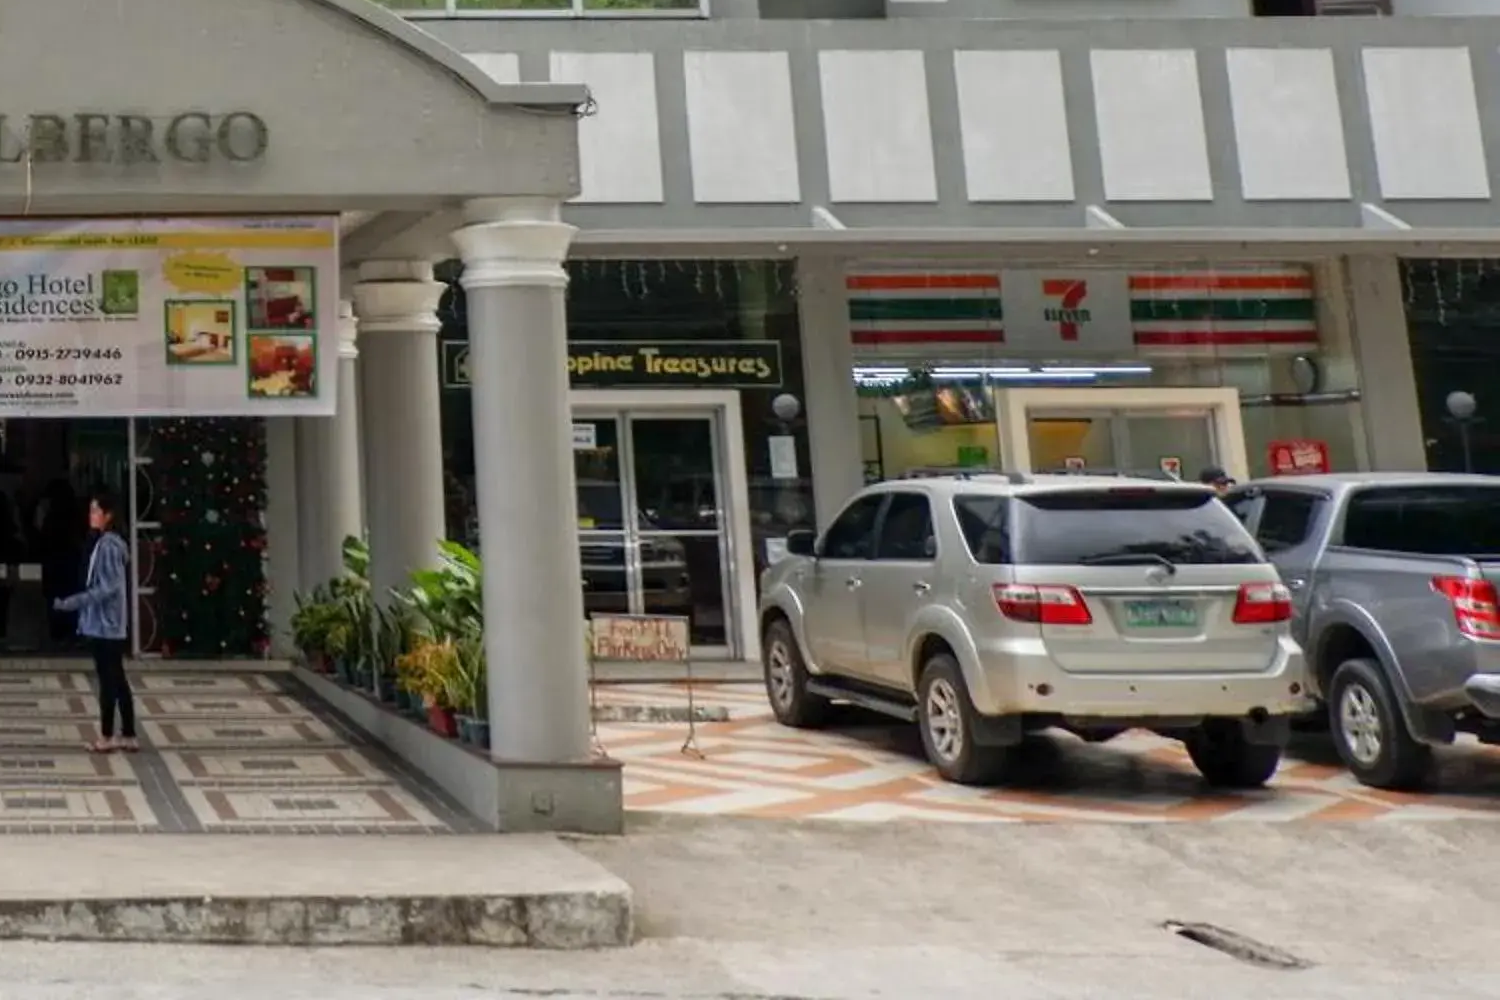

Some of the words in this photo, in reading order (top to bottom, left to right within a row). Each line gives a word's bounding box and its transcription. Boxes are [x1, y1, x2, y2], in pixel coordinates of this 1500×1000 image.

[27, 272, 94, 296] Hotel
[1042, 279, 1088, 342] 7
[639, 348, 771, 378] Treasures
